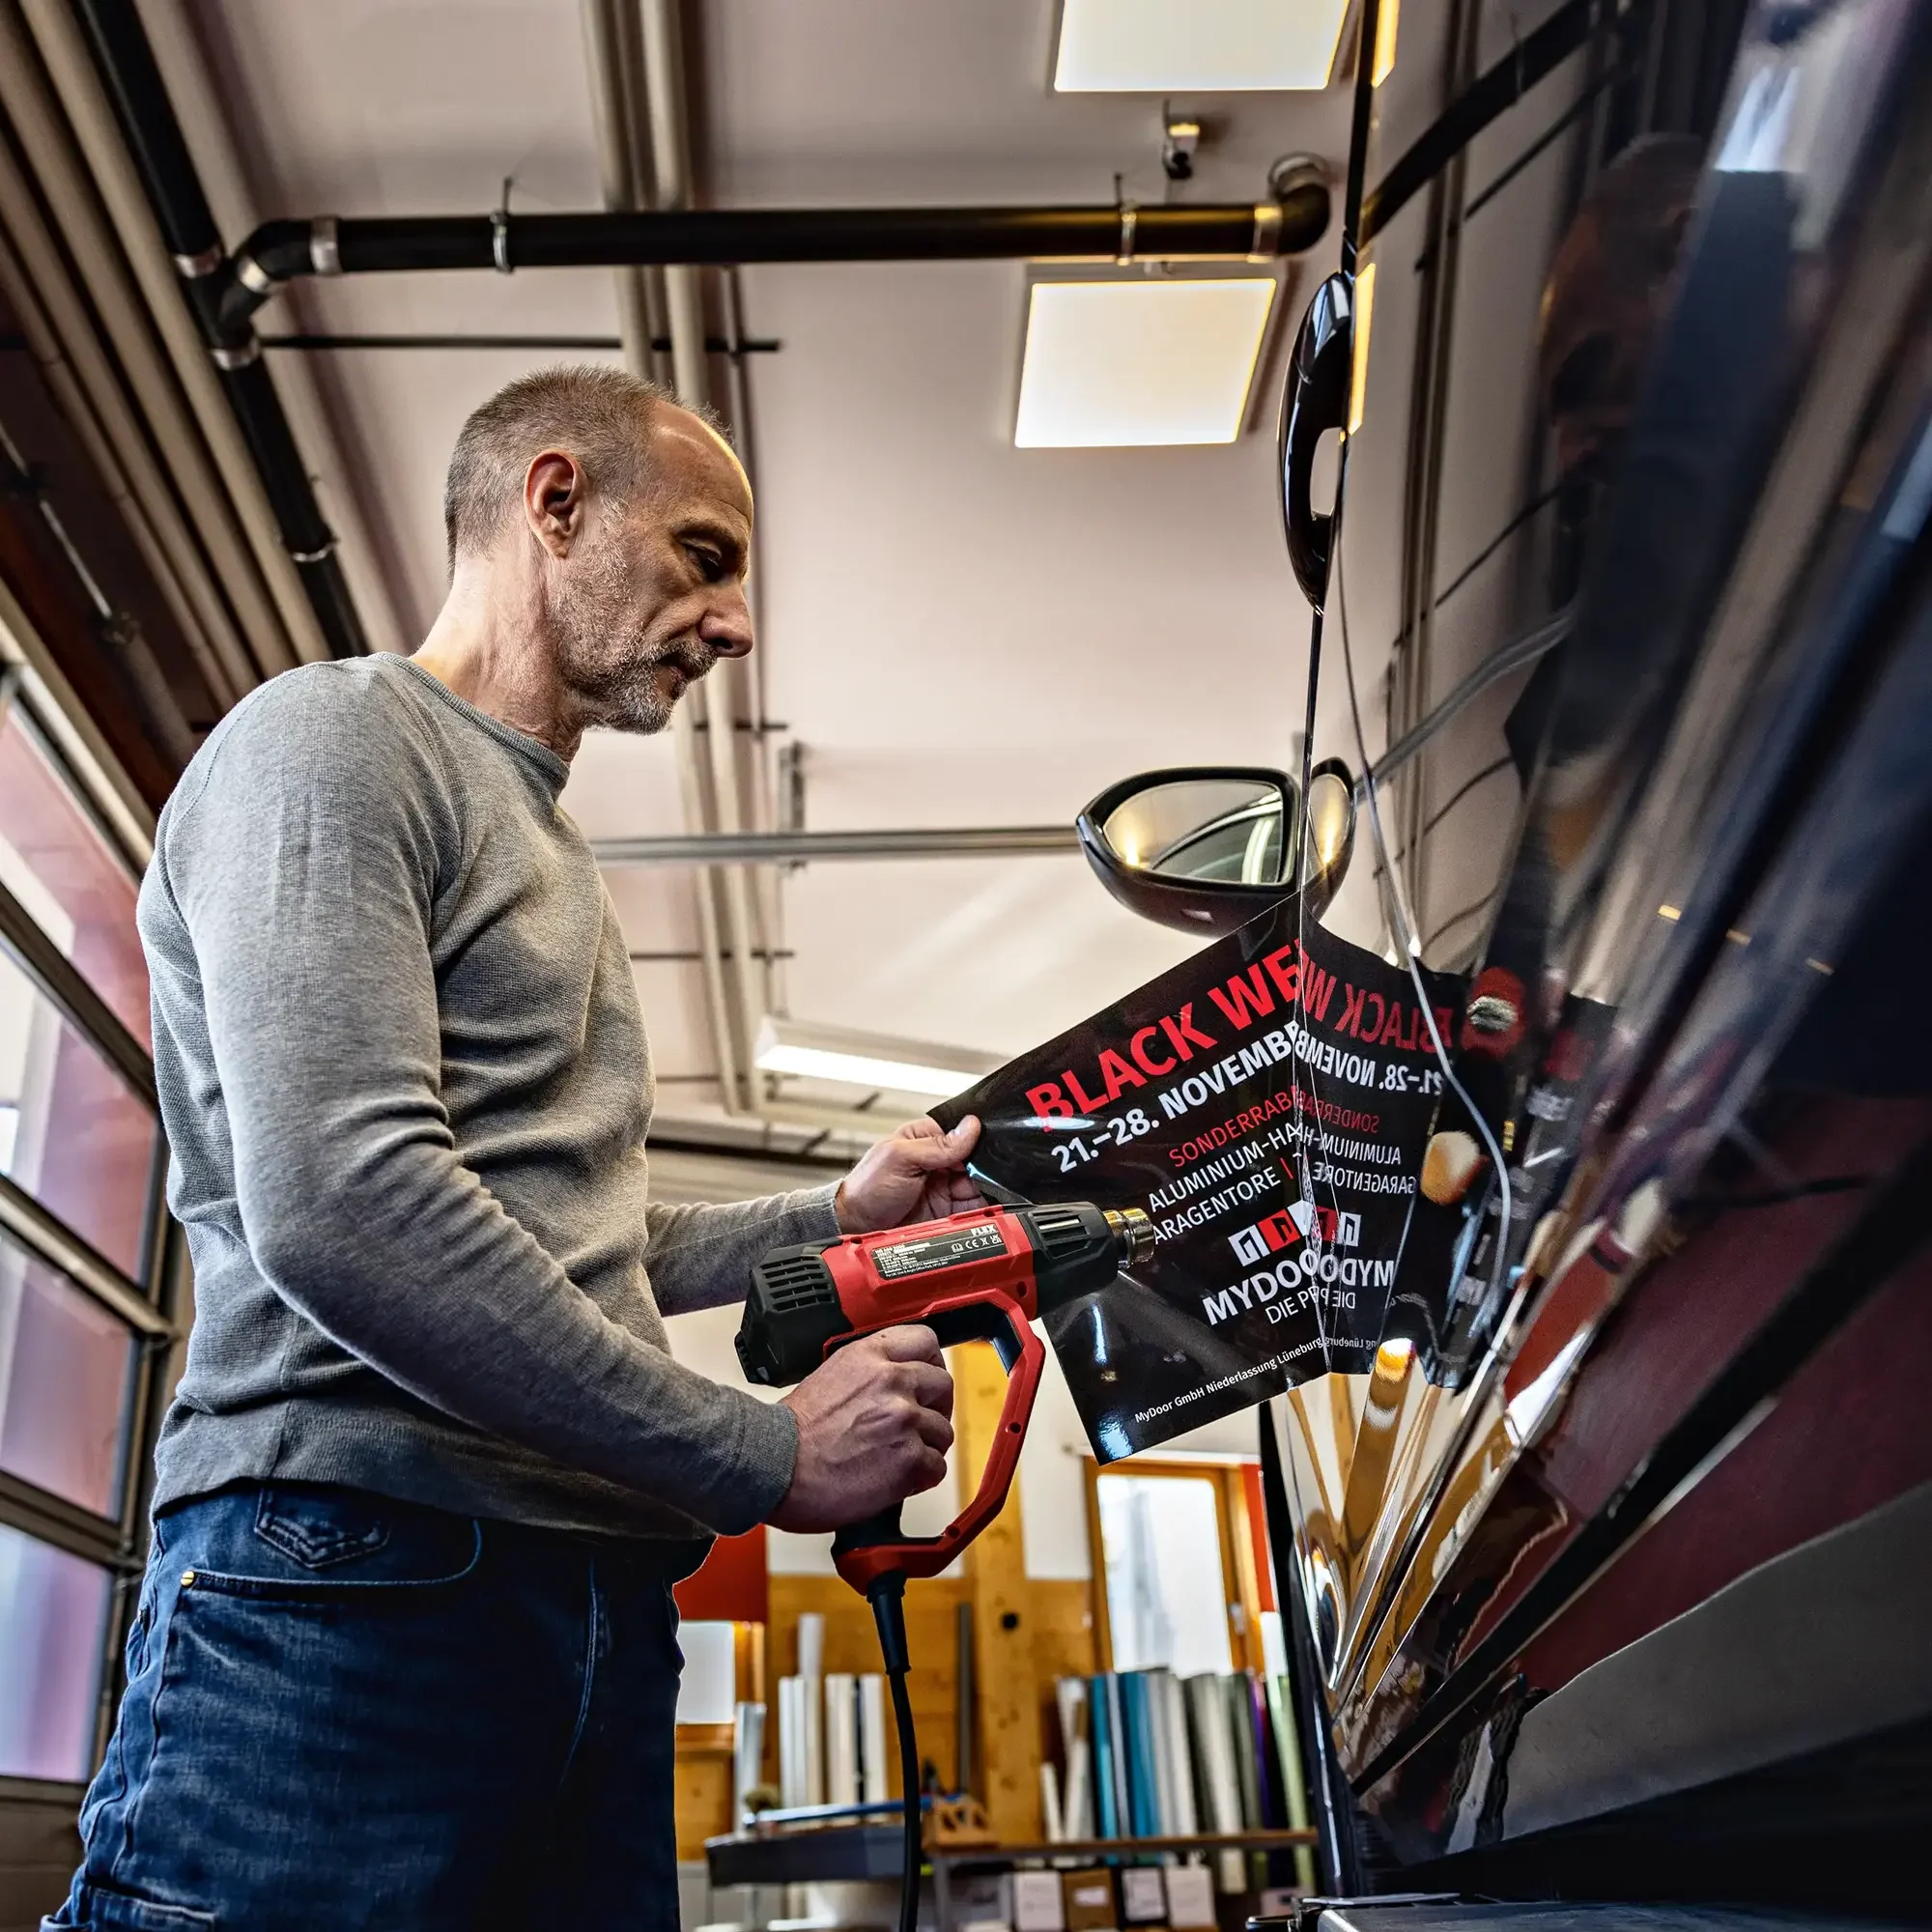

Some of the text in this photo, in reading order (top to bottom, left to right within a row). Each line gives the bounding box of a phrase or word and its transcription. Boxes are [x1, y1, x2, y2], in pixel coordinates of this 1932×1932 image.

[1025, 938, 1300, 1132] BLACK WE
[1169, 1085, 1296, 1167] SONDERRAB
[1152, 1166, 1281, 1245] ARAGENTORE
[1264, 1296, 1298, 1324] DIE
[1134, 1337, 1323, 1423] MyDoor GmbH Niederlassung Lüneburg
